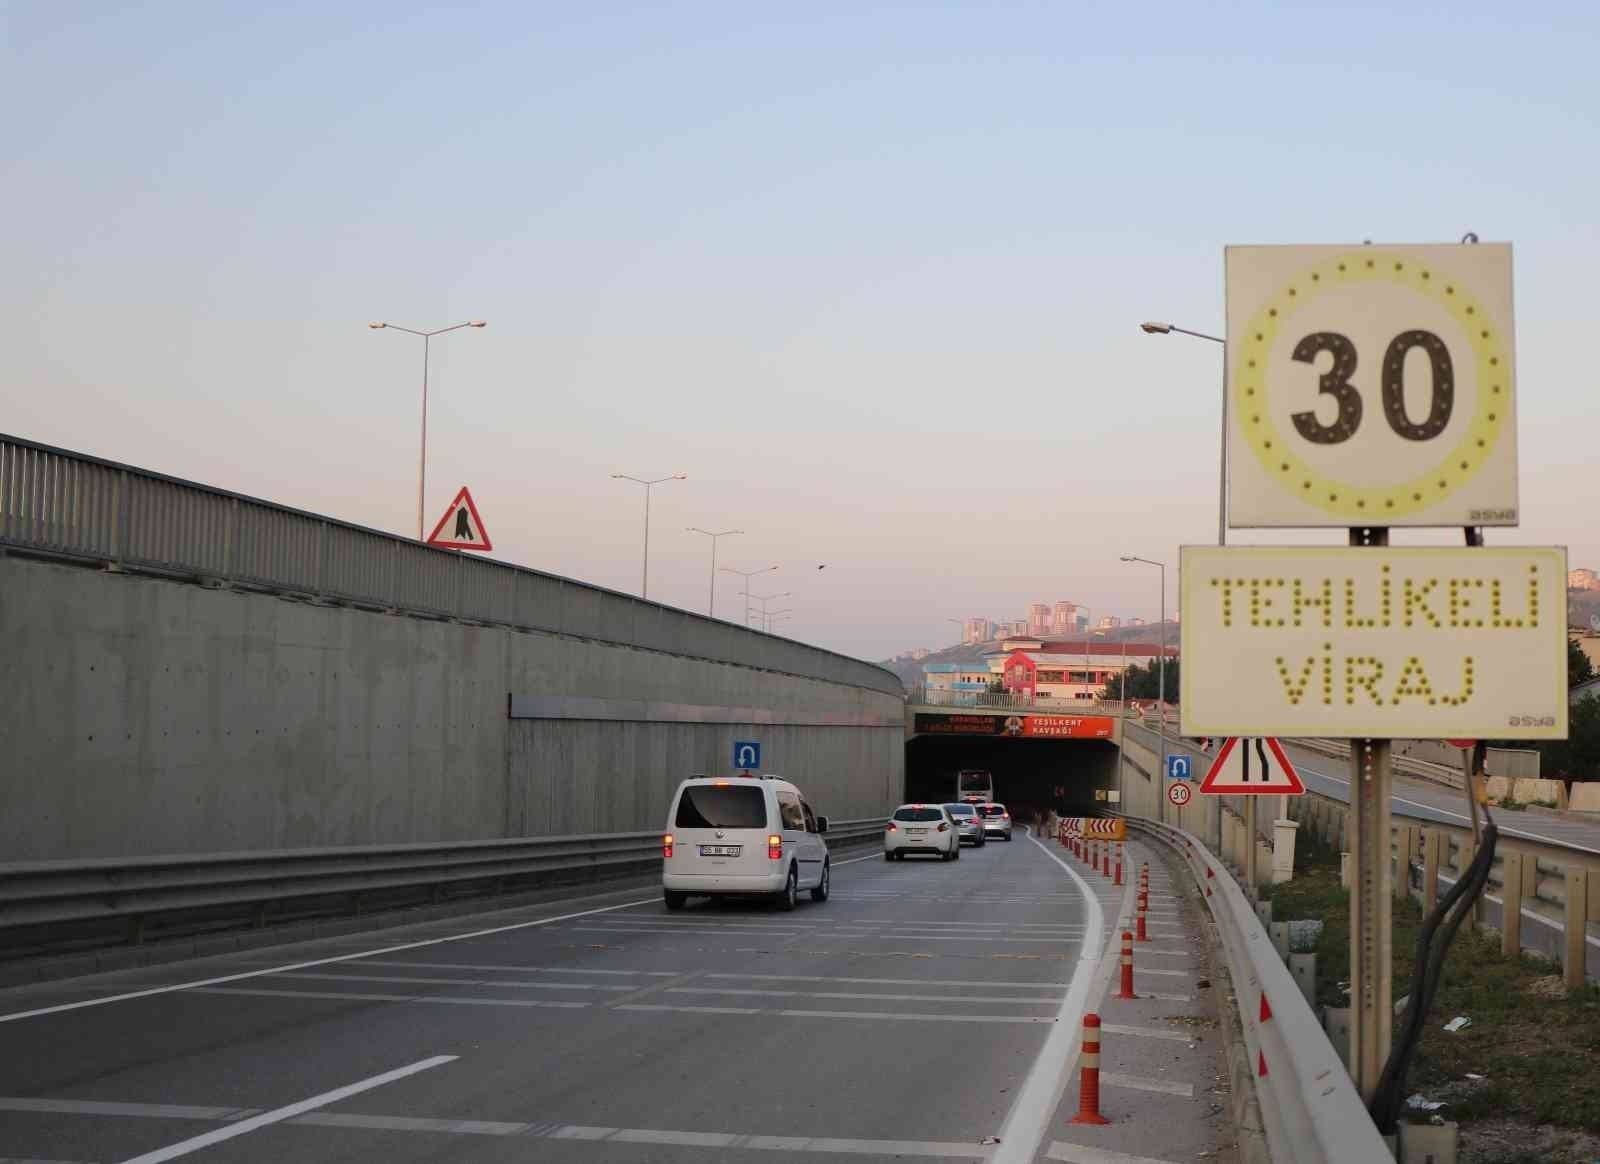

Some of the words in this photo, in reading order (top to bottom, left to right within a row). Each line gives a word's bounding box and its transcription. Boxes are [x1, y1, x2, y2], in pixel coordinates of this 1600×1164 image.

[1290, 329, 1455, 445] 30
[1210, 564, 1539, 628] TEHLİKELİ
[1275, 642, 1474, 707] VİRAJ
[1172, 788, 1187, 800] 30
